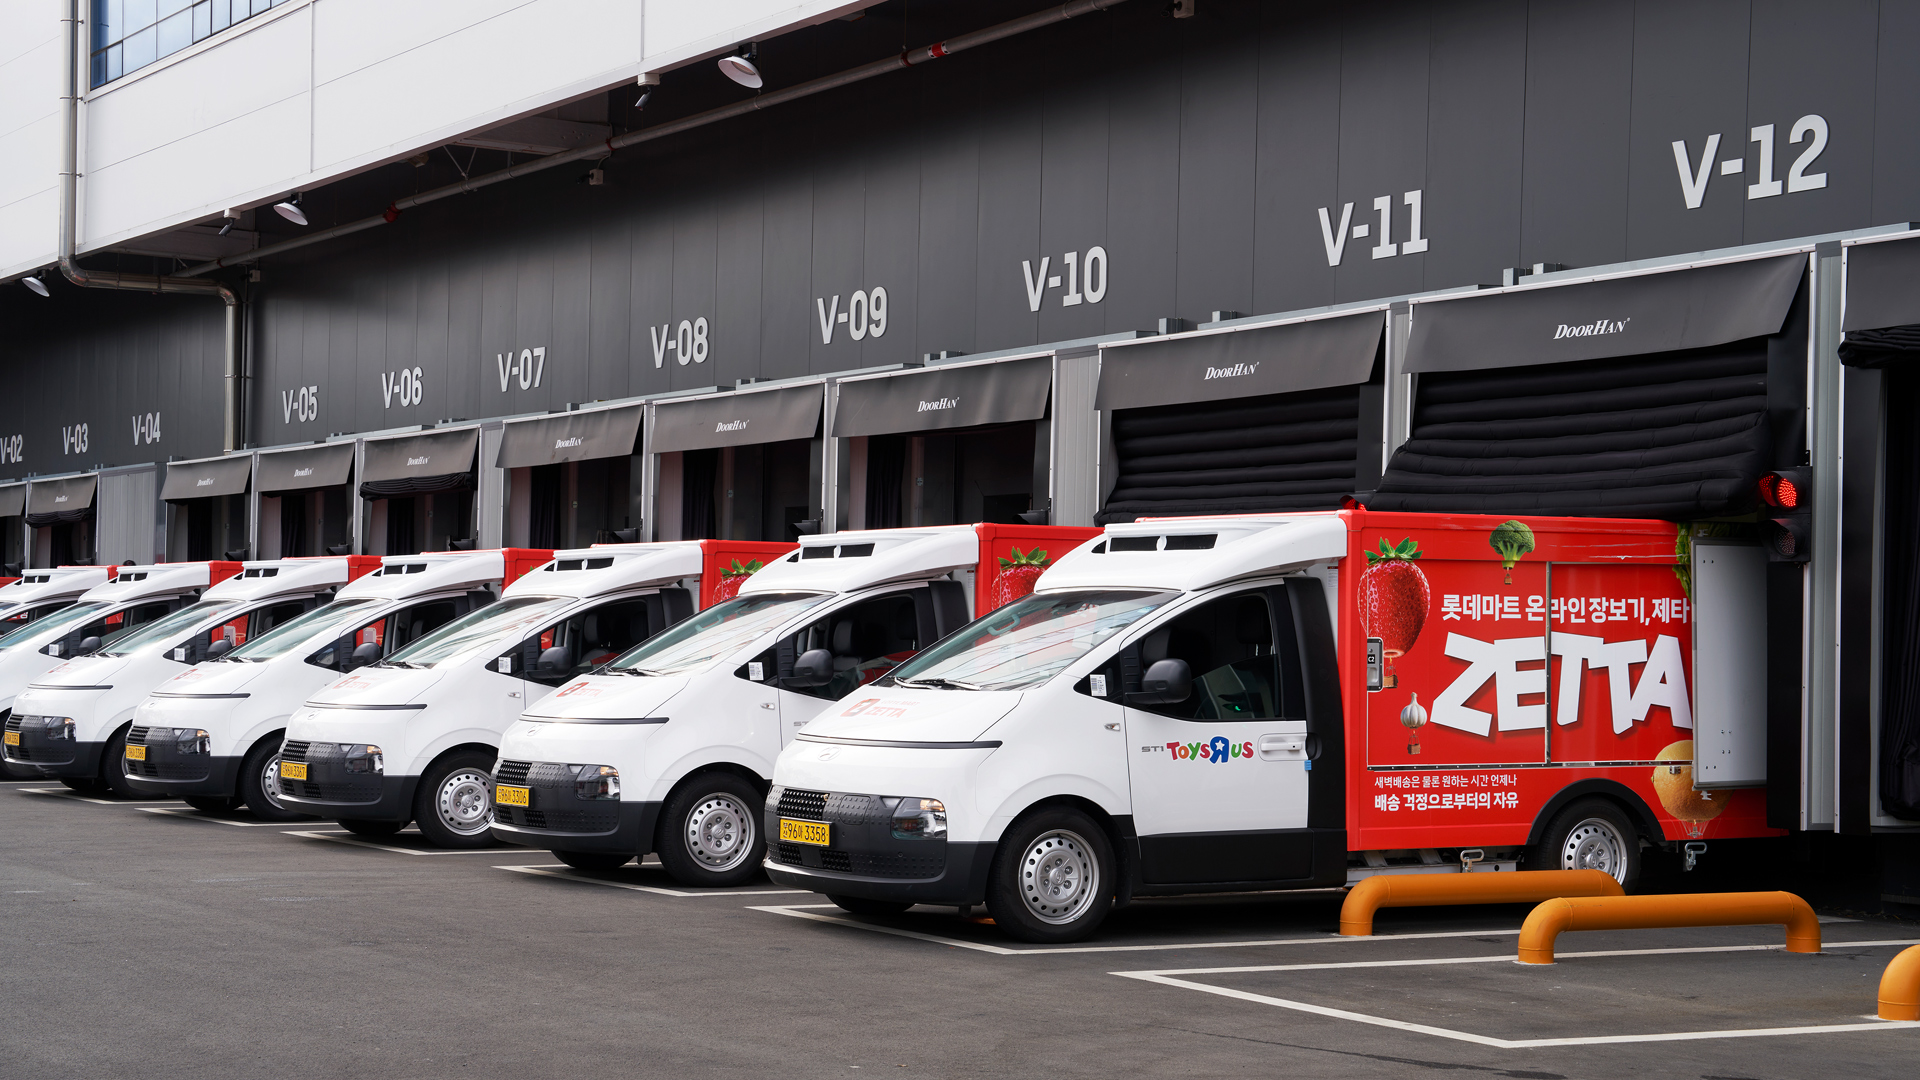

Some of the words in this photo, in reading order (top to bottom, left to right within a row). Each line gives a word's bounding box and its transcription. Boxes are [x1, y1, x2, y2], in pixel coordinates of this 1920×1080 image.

[1672, 115, 1827, 209] V-12
[1318, 190, 1428, 266] V-11
[1023, 246, 1107, 312] V-10
[817, 287, 887, 344] V-09
[651, 317, 708, 368] V-08
[498, 347, 546, 392] V-07
[283, 386, 318, 424] V-05
[382, 367, 423, 409] V-06
[63, 423, 88, 455] V-03
[133, 412, 161, 446] V-04
[0, 434, 23, 464] V-02
[1441, 594, 1521, 621] 롯데마트
[1430, 631, 1693, 737] ZETTA
[863, 706, 907, 718] ZETTA
[512, 789, 527, 804] 3306
[1374, 775, 1420, 788] 새벽배송은
[1422, 775, 1440, 788] 물론
[1442, 775, 1469, 787] 원하는
[1470, 774, 1489, 787] 시간
[1490, 774, 1517, 786] 언제나
[1374, 793, 1400, 811] 배송
[1403, 792, 1490, 811] 걱정으로부터의
[1493, 791, 1519, 809] 자유
[805, 824, 826, 842] 3358
